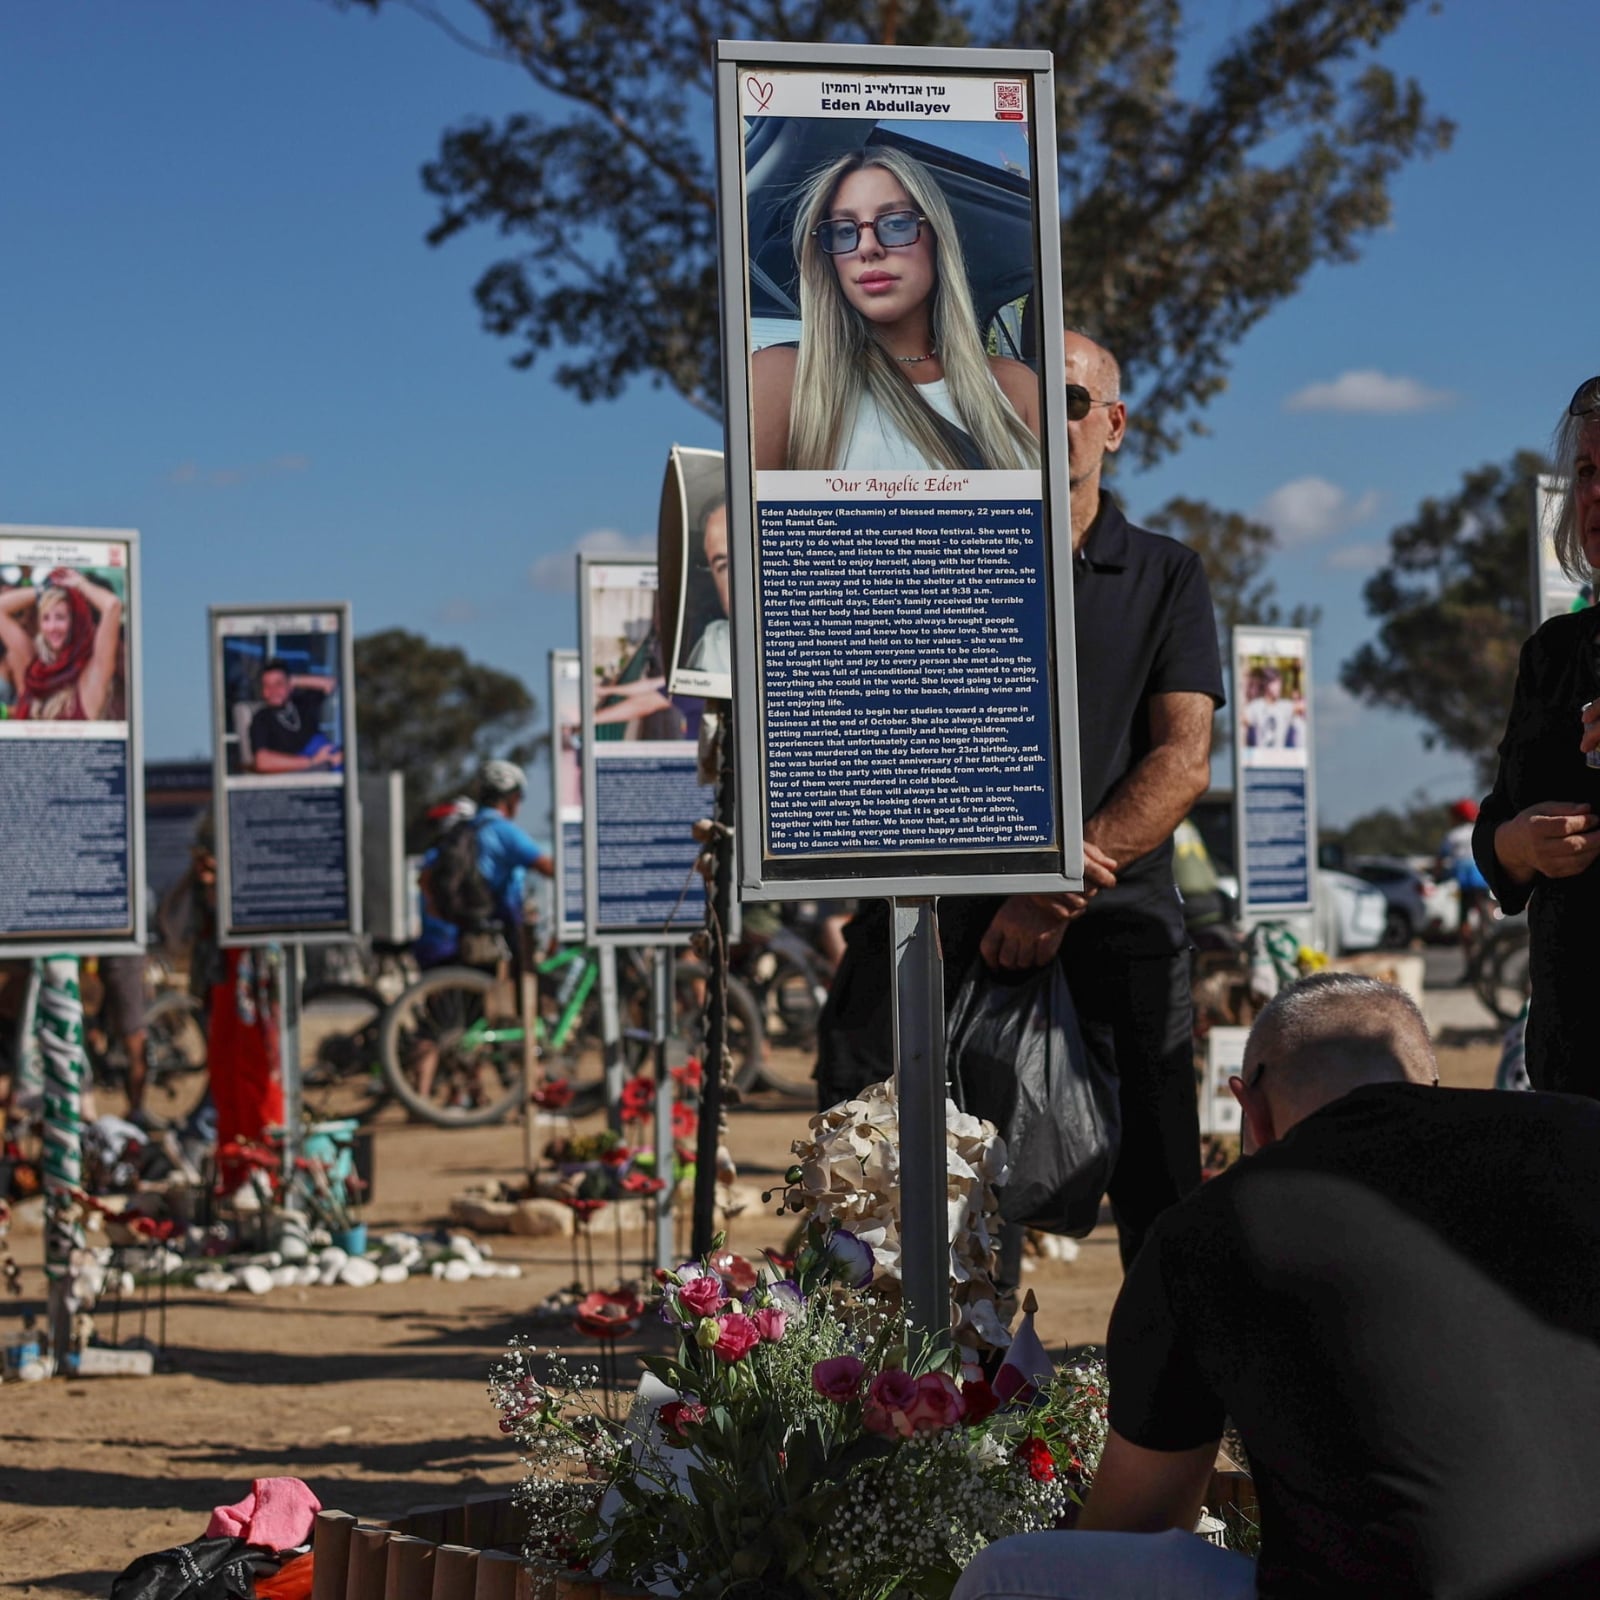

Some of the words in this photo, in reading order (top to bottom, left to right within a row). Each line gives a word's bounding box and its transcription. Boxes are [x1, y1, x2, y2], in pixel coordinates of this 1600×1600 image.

[865, 83, 922, 95] אבדולאייב
[926, 85, 945, 97] עדן
[821, 99, 860, 111] Eden
[866, 100, 950, 115] Abdullayev
[866, 475, 919, 498] Angelic
[787, 508, 833, 518] Abdulayev
[835, 508, 886, 517] (Rachamin)
[937, 509, 975, 517] memory,
[991, 509, 1015, 517] years
[1017, 508, 1034, 516] old,
[849, 558, 874, 567] enjoy
[876, 558, 909, 566] herself,
[912, 558, 936, 567] along
[809, 589, 843, 597] parking
[764, 599, 787, 607] After
[808, 598, 843, 606] difficult
[846, 598, 870, 607] days,
[904, 597, 932, 606] family
[768, 619, 790, 627] Eden
[855, 618, 891, 627] magnet,
[915, 617, 946, 626] always
[948, 617, 983, 626] brought
[985, 617, 1015, 625] people
[766, 649, 785, 657] kind
[800, 650, 831, 658] person
[875, 649, 916, 657] everyone
[972, 646, 999, 654] close.
[767, 679, 815, 688] everything
[836, 678, 861, 686] could
[891, 677, 919, 685] world.
[966, 676, 991, 685] going
[1005, 675, 1039, 684] parties,
[793, 709, 810, 717] had
[866, 708, 891, 717] begin
[893, 707, 908, 715] her
[945, 706, 976, 714] toward
[987, 705, 1018, 714] degree
[768, 730, 801, 739] getting
[803, 729, 841, 738] married,
[844, 728, 879, 737] starting
[890, 727, 917, 736] family
[939, 726, 968, 735] having
[970, 725, 1009, 734] children,
[769, 750, 792, 758] Eden
[815, 748, 859, 756] murdered
[892, 747, 908, 756] day
[981, 745, 1020, 754] birthday,
[1022, 744, 1038, 752] and
[770, 780, 788, 788] four
[802, 779, 826, 787] them
[853, 778, 896, 786] murdered
[931, 776, 958, 784] blood.
[810, 799, 827, 807] will
[829, 799, 861, 808] always
[877, 797, 910, 807] looking
[963, 795, 983, 803] from
[986, 795, 1015, 803] above,
[772, 841, 797, 850] along
[811, 839, 839, 847] dance
[864, 838, 881, 846] her.
[899, 836, 936, 846] promise
[949, 835, 995, 843] remember
[1014, 834, 1047, 843] always.
